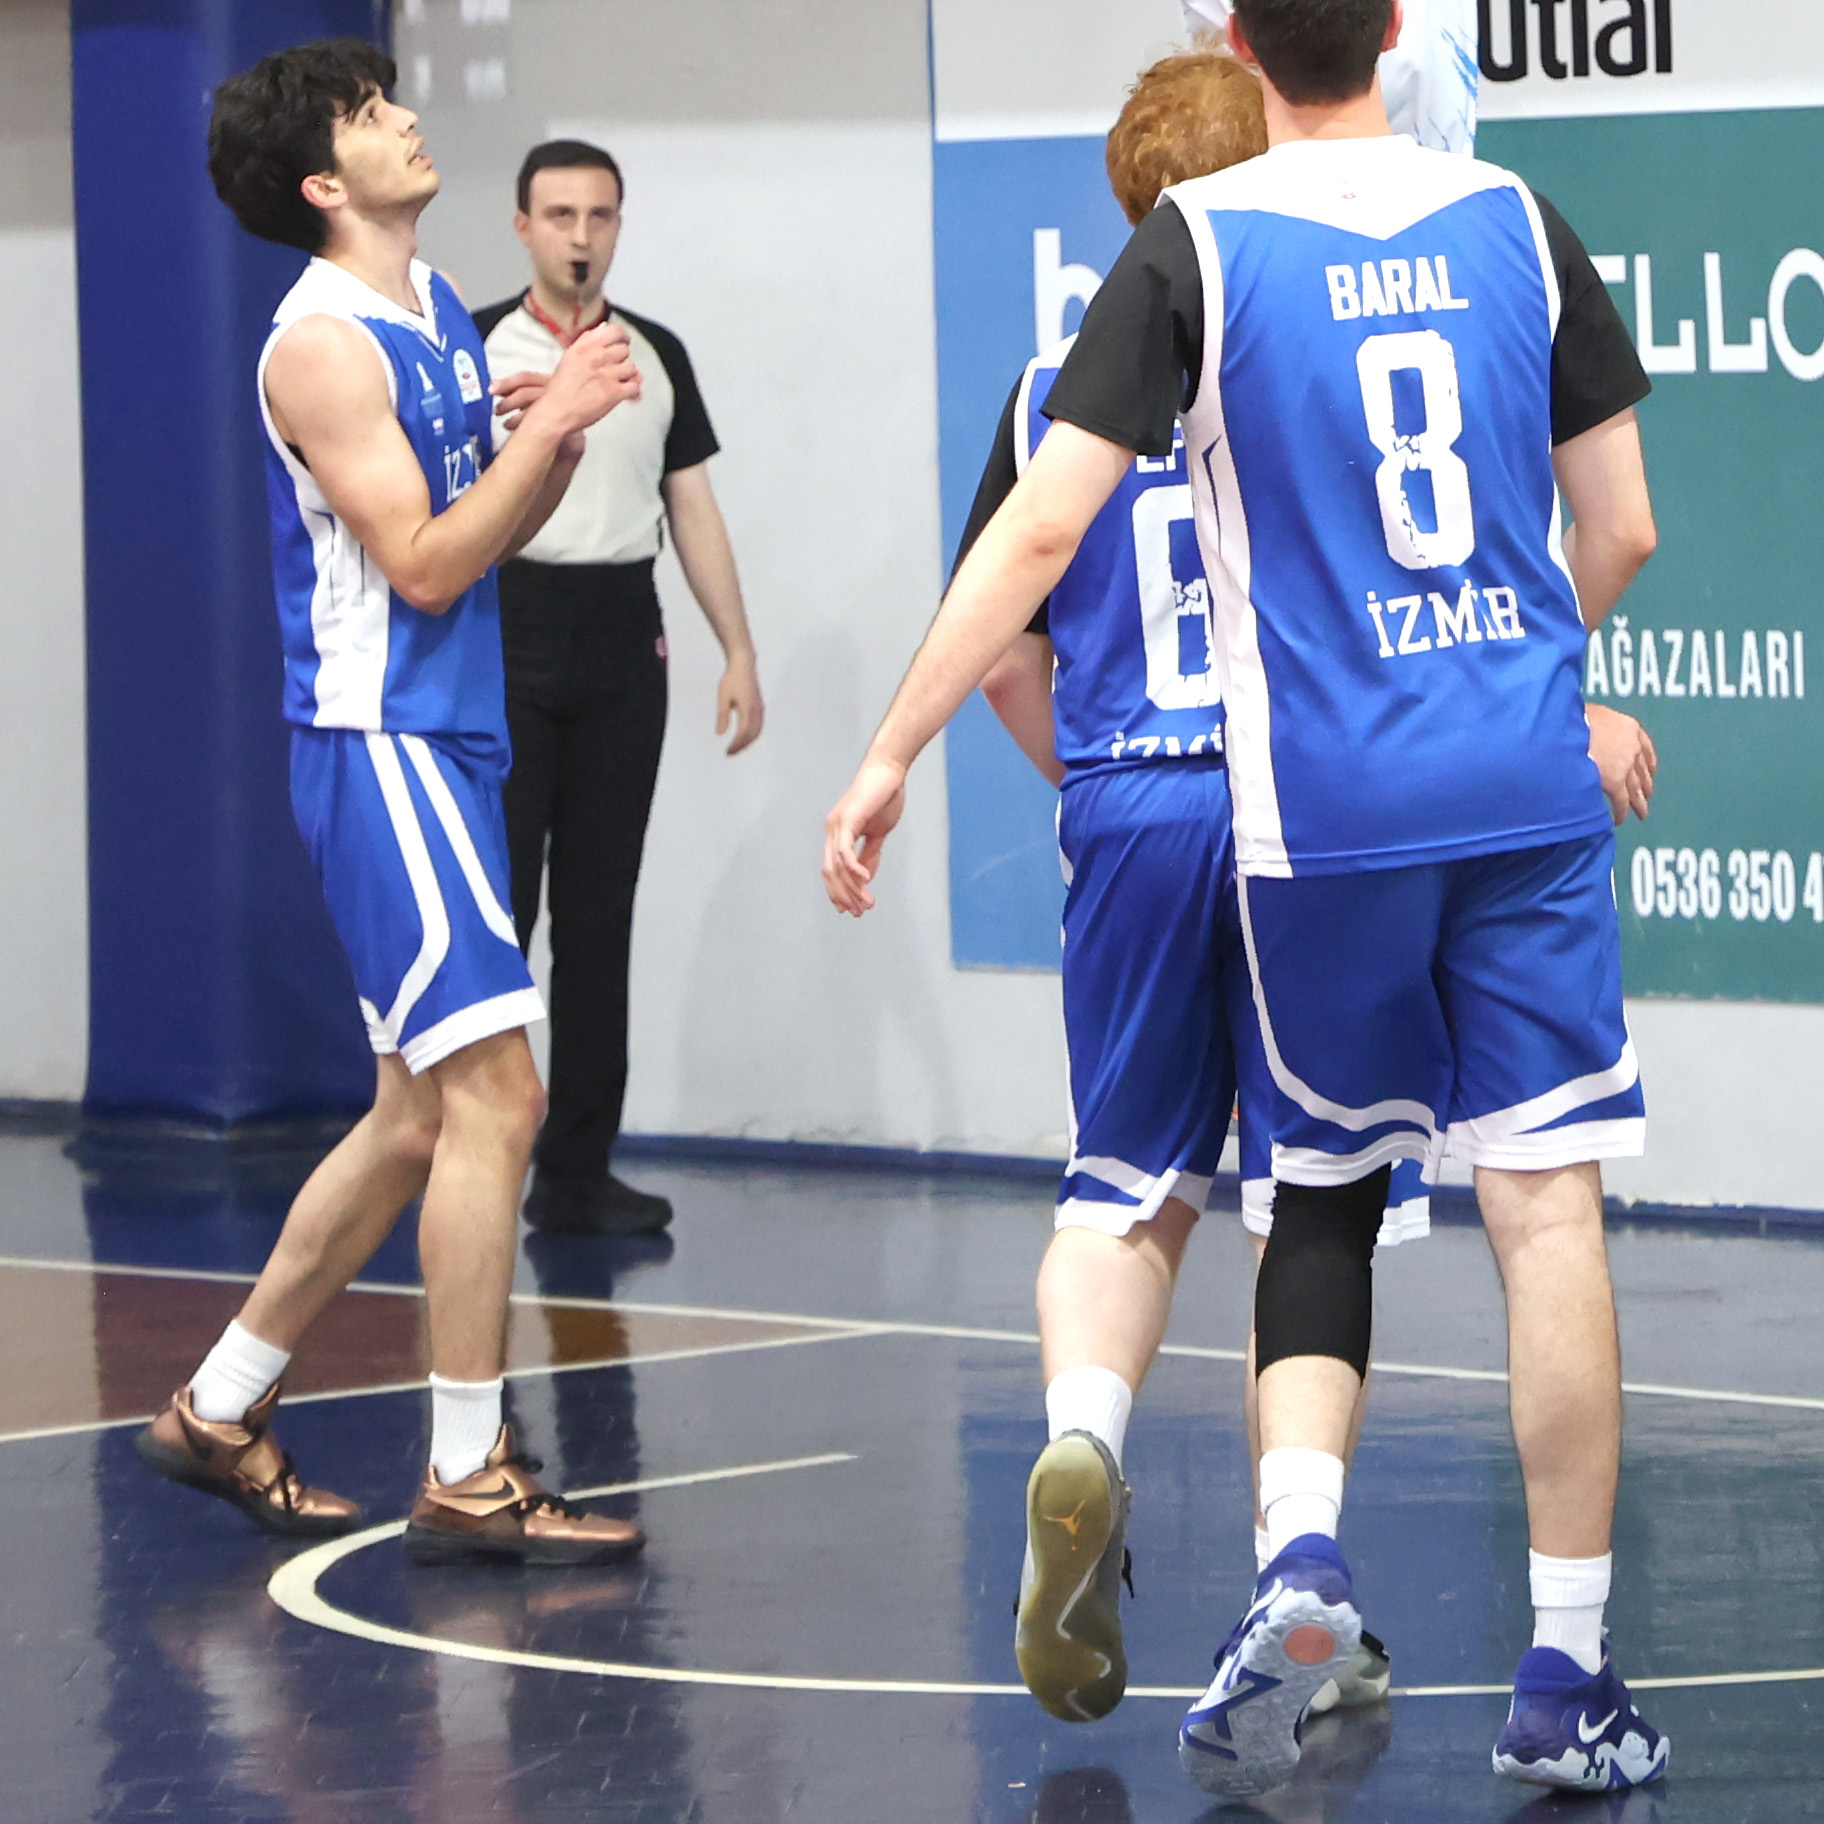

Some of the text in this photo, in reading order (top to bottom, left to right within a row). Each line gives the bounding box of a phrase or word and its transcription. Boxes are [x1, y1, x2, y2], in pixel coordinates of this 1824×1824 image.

[1324, 254, 1469, 322] BARAL
[1354, 328, 1476, 571] 8
[1579, 614, 1805, 700] AĞAZALARI
[1630, 845, 1722, 920] 0536
[1728, 847, 1796, 923] 350
